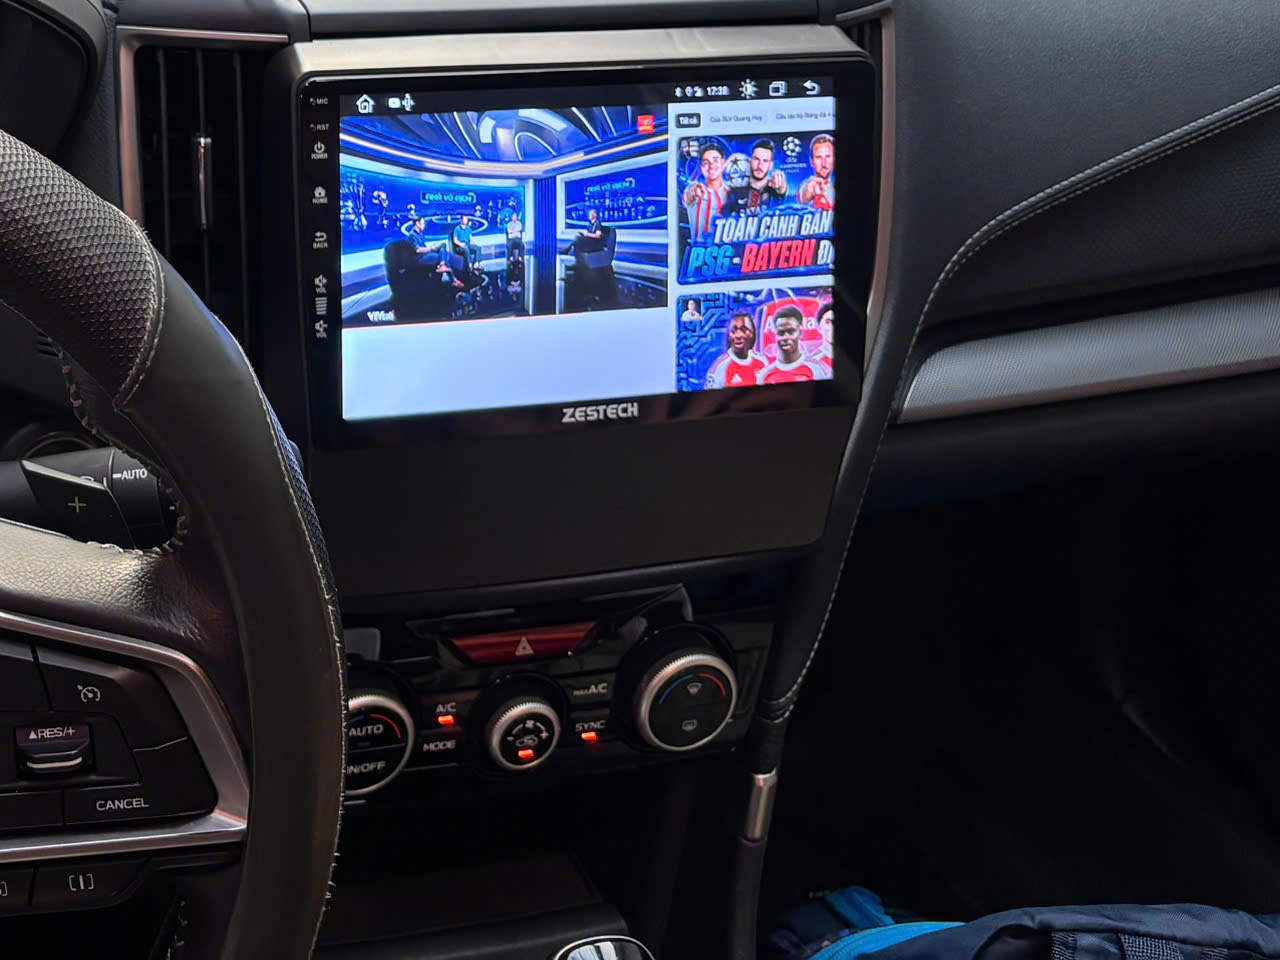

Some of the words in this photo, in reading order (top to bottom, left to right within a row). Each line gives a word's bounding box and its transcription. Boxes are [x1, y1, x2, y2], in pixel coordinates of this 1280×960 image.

[714, 210, 758, 243] TOÀN
[741, 239, 816, 273] BAYERN
[561, 402, 639, 423] ZESTECH
[121, 468, 148, 480] AUTO
[435, 702, 457, 713] A/C
[348, 724, 384, 736] AUTO
[575, 720, 607, 731] SYNC
[423, 740, 456, 752] MODE
[96, 798, 150, 811] CANCEL
